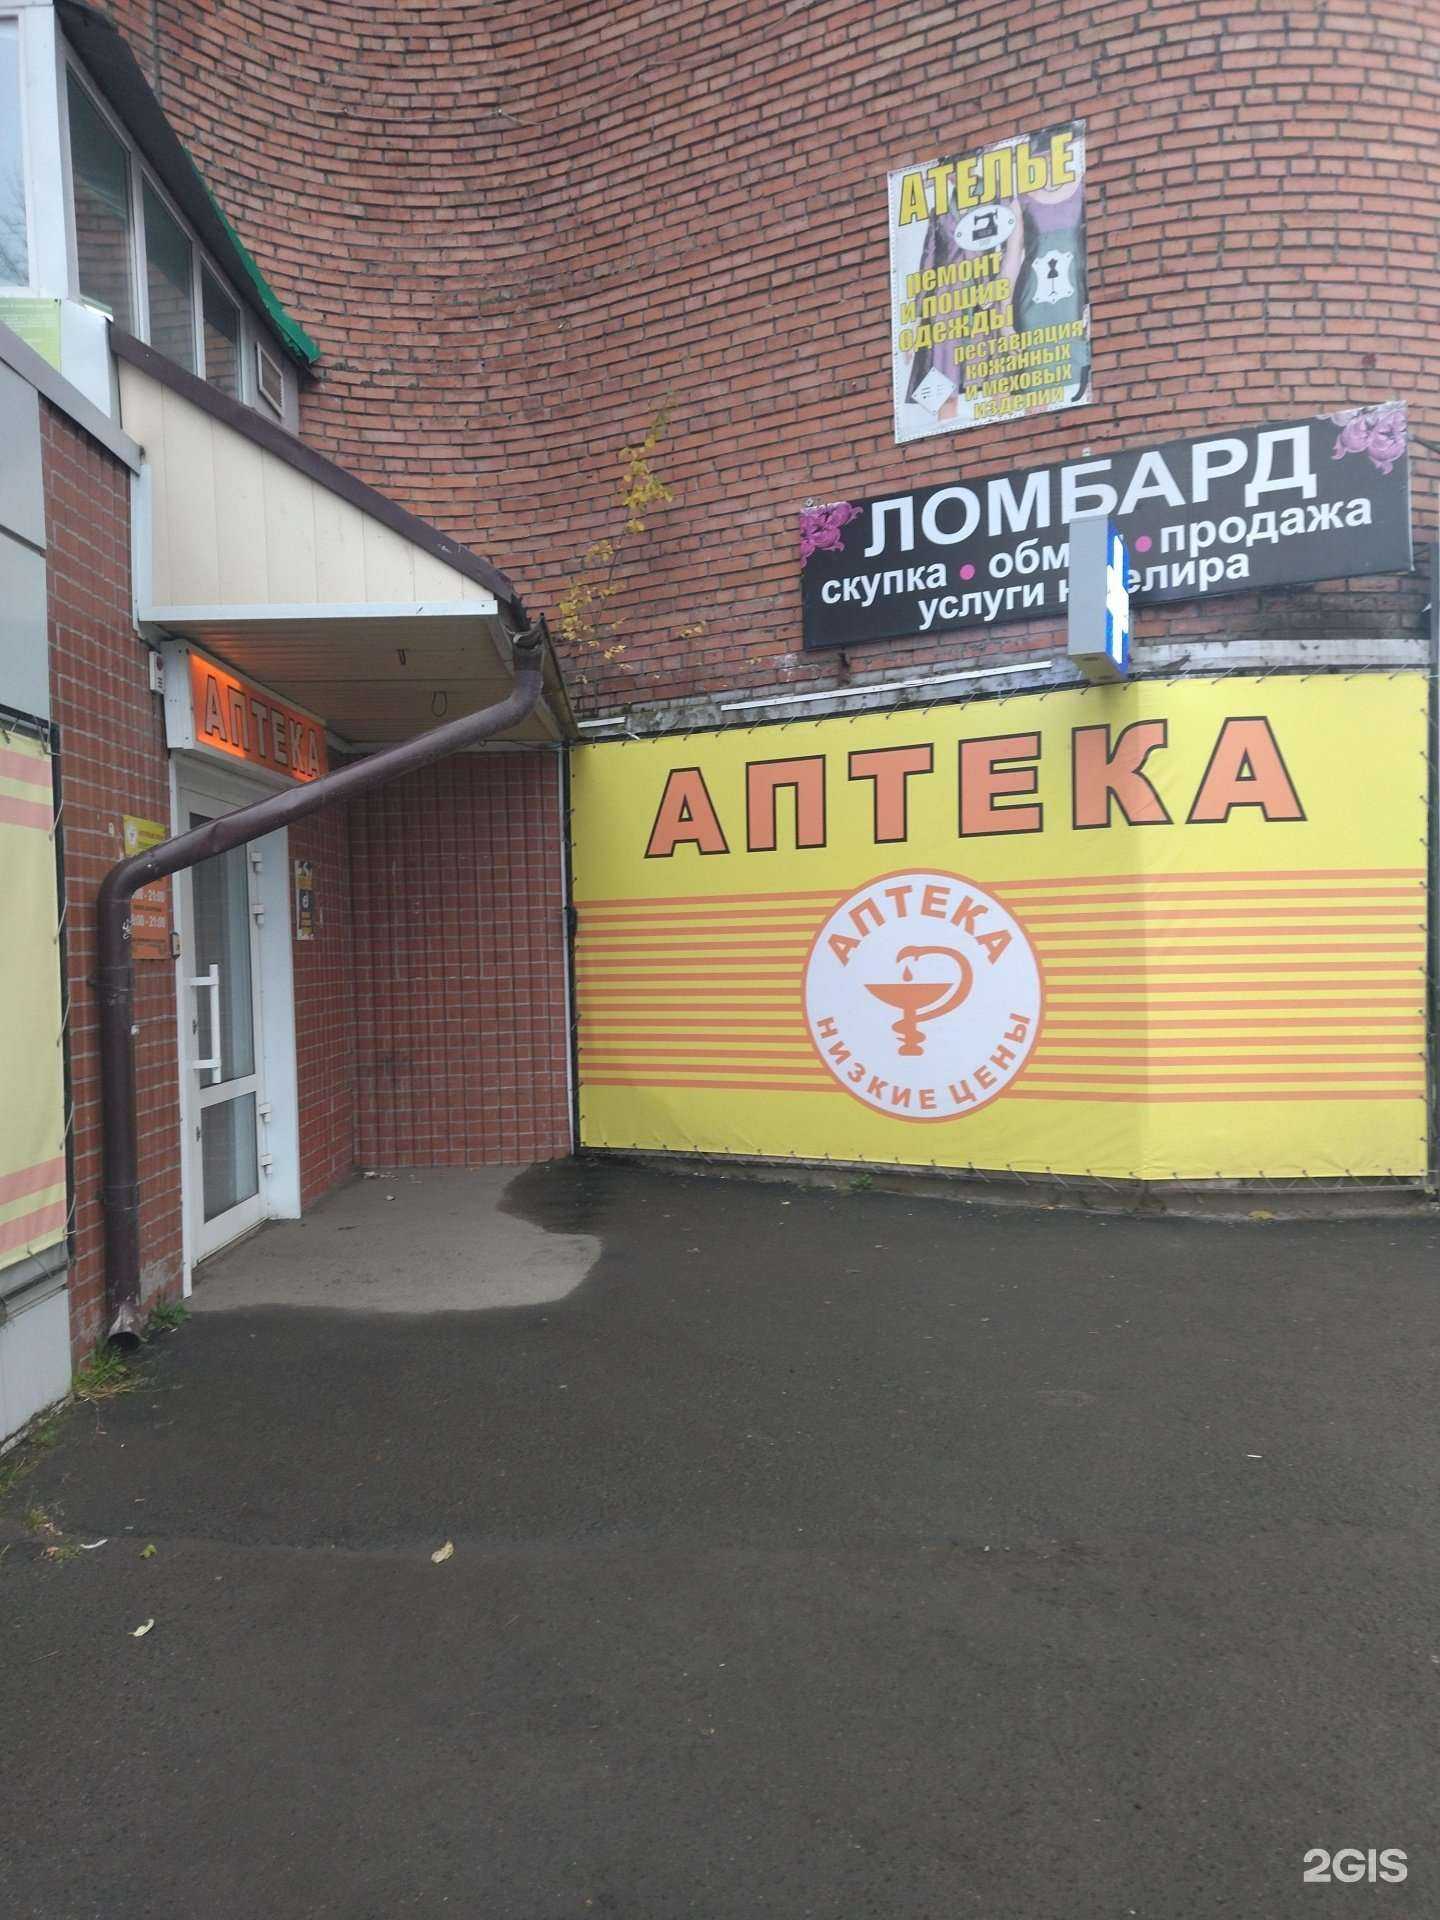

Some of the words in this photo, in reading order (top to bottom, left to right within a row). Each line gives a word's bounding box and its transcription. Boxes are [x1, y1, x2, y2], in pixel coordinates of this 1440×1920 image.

[899, 132, 1076, 226] АТЕЛЬЕ
[900, 303, 916, 325] и
[922, 279, 1011, 318] пошив
[906, 253, 1003, 299] ремонт
[899, 304, 1014, 352] одежды
[954, 319, 1084, 364] реставрация
[965, 343, 1072, 380] кожанных
[965, 385, 978, 401] и
[982, 364, 1072, 397] меховых
[864, 425, 1318, 557] ЛОМБАРД
[821, 559, 947, 605] скупка
[988, 538, 1071, 579] обм
[1161, 497, 1373, 555] продажа
[919, 582, 1045, 630] услуги
[204, 674, 320, 778] АПТЕКА
[644, 715, 1308, 859] АПТЕКА
[827, 884, 1013, 967] АПТЕКА
[817, 1017, 937, 1110] НИЗКИЕ
[948, 1013, 1031, 1104] ЦЕНЫ
